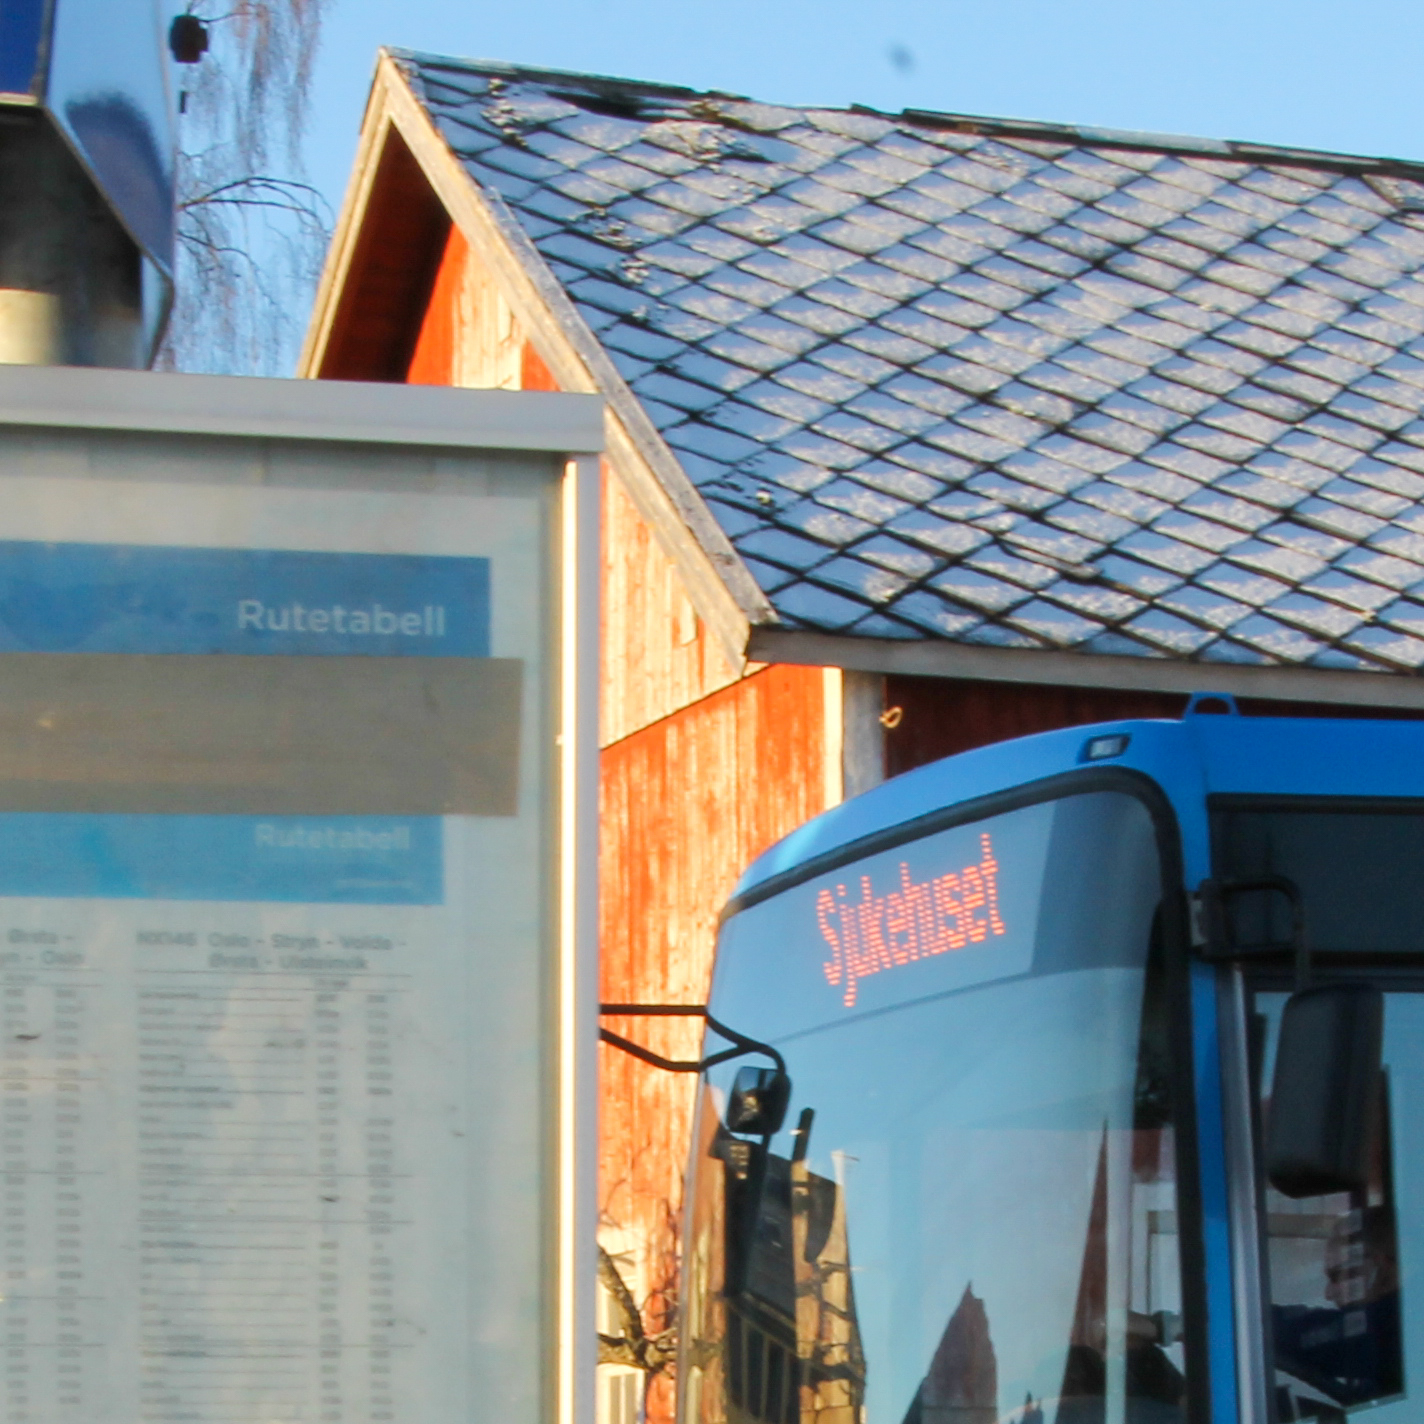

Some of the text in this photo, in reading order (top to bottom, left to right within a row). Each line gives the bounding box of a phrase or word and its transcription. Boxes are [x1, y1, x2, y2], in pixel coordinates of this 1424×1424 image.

[238, 599, 444, 636] Rutetabell
[254, 822, 410, 850] Rutetabell
[816, 833, 1005, 1007] Sjukehuset
